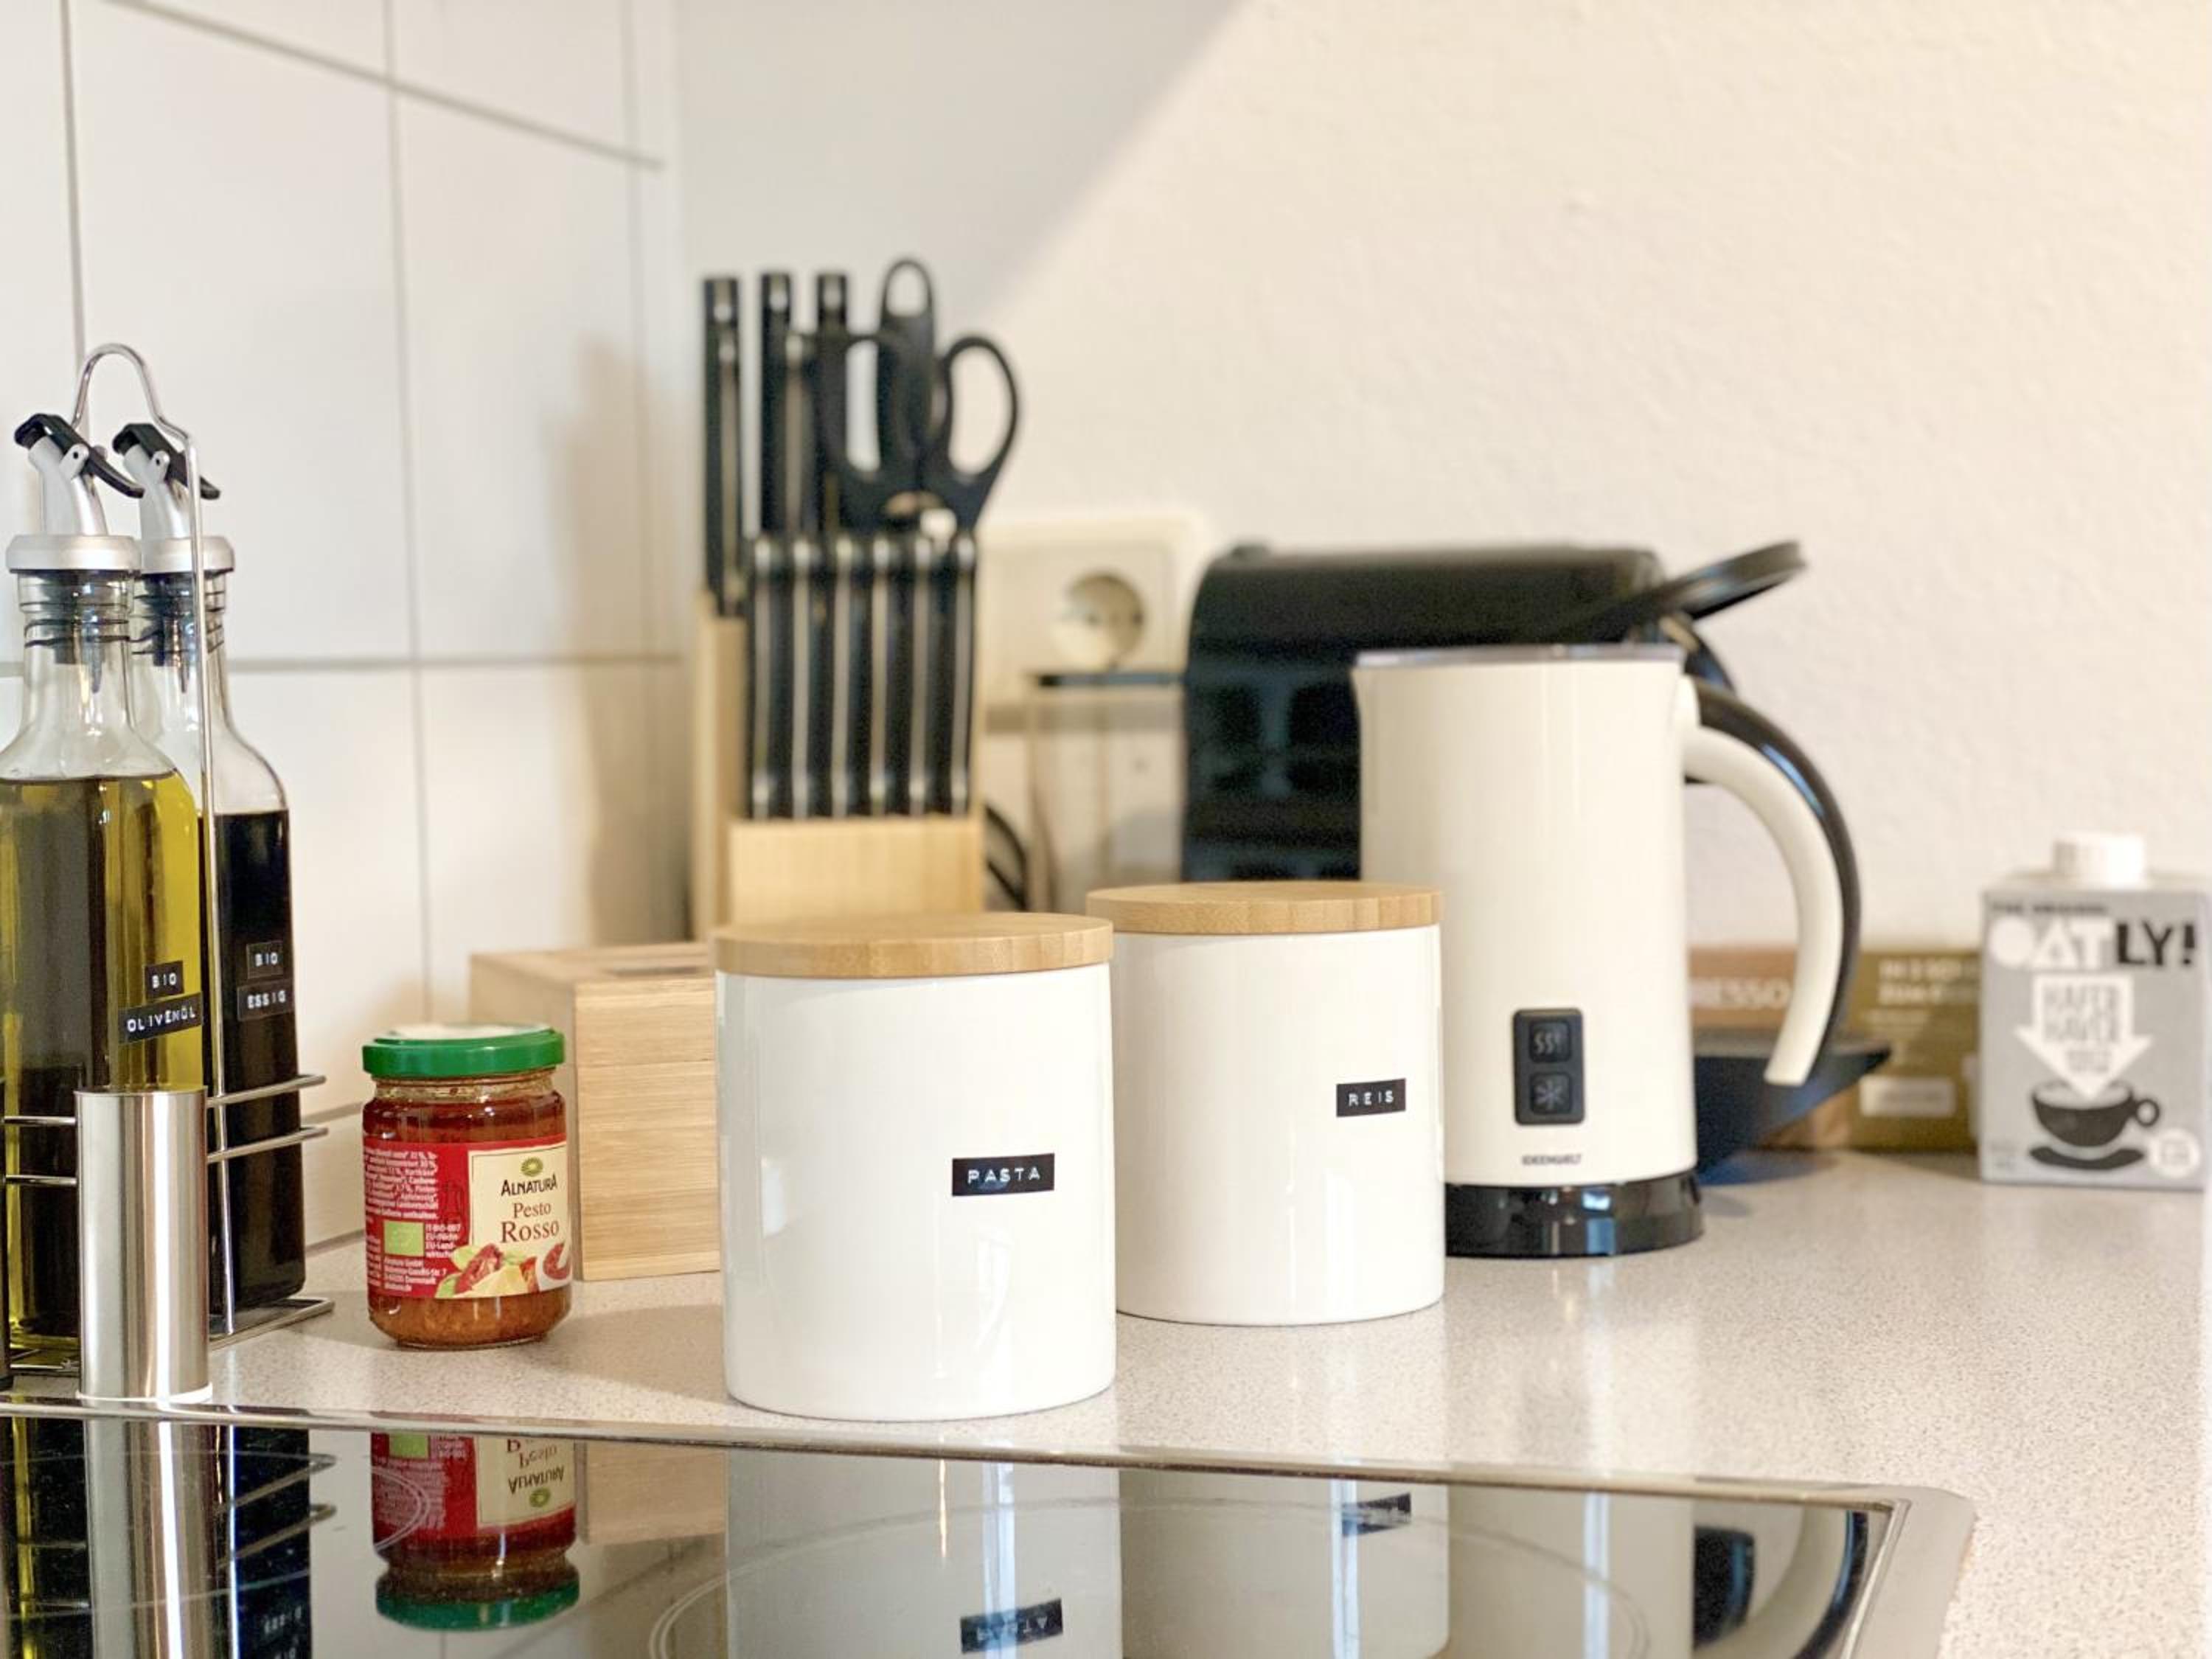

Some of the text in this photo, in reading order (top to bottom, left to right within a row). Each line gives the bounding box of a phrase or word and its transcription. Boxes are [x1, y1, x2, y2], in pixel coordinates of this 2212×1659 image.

[1989, 917, 2196, 969] OATLY!
[255, 952, 278, 967] BIO
[151, 973, 176, 989] BIO
[247, 990, 286, 1009] ESSIG
[1348, 1089, 1394, 1107] REIS
[967, 1166, 1040, 1184] PASTA
[512, 1201, 552, 1219] Pesto
